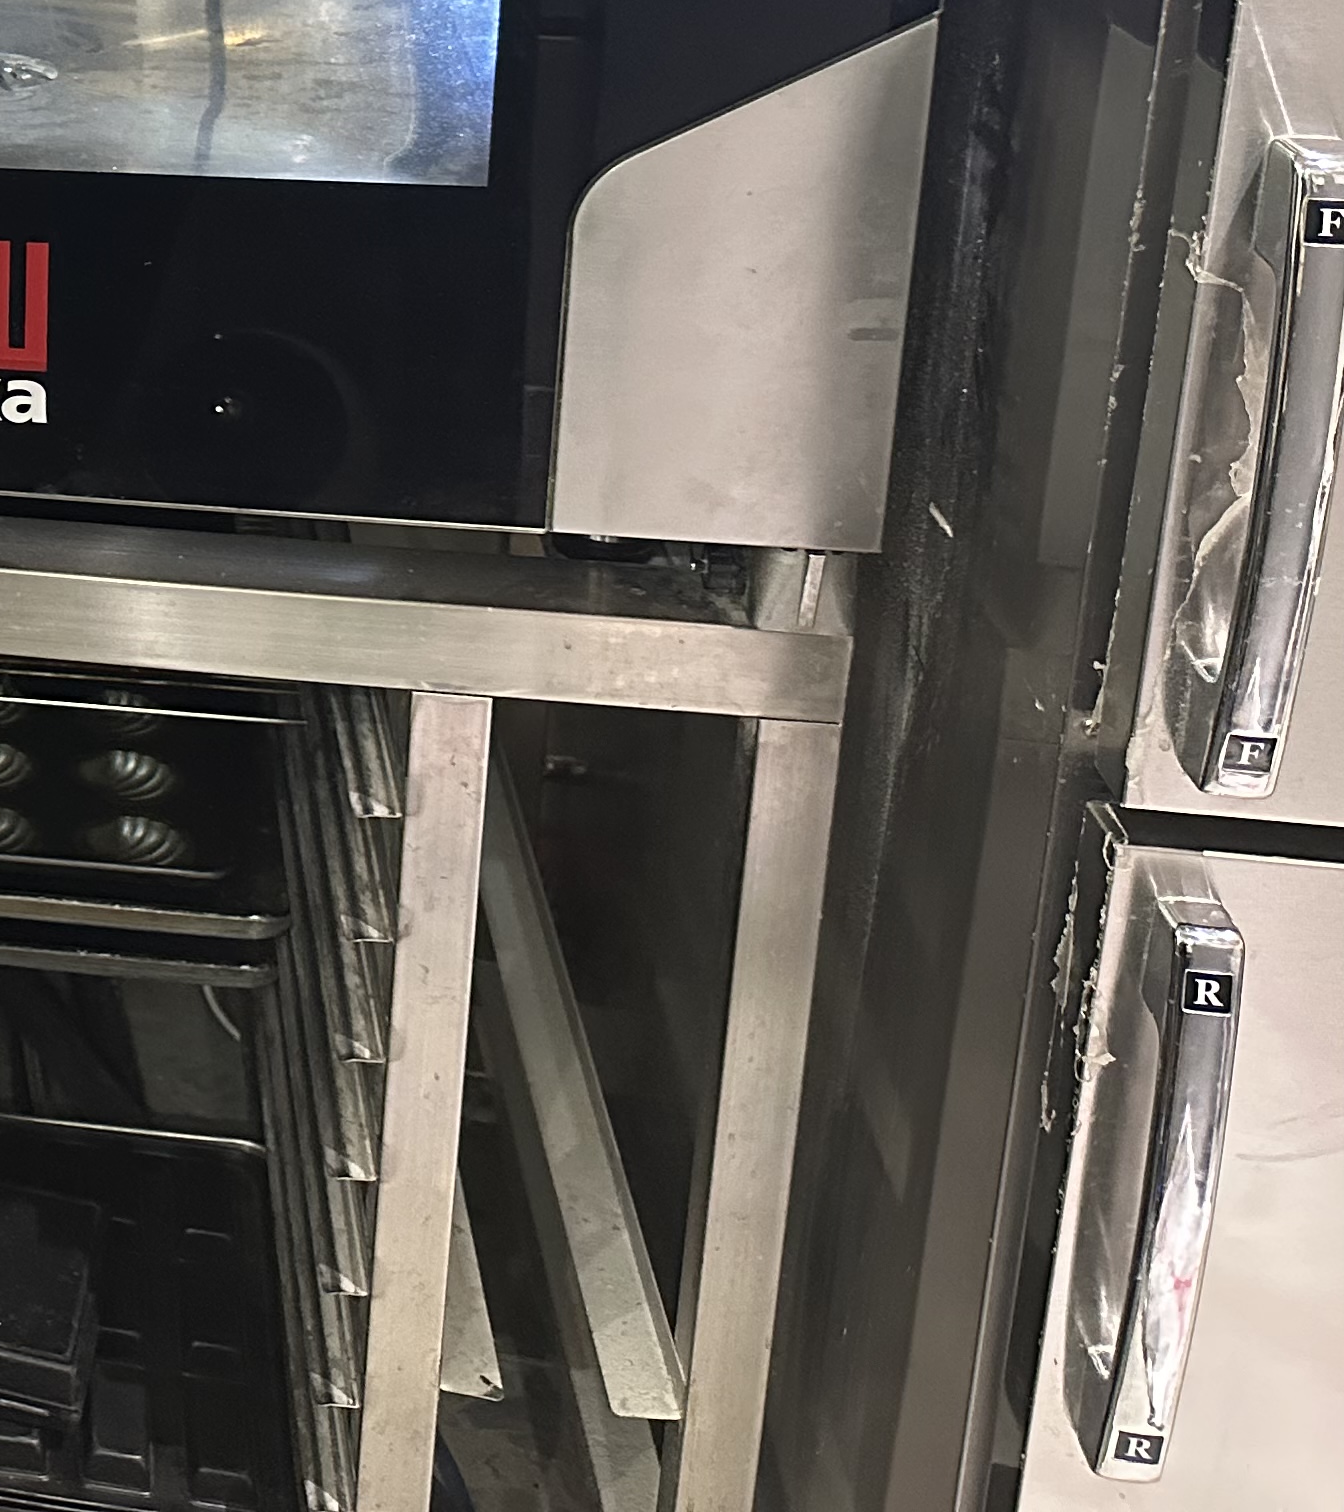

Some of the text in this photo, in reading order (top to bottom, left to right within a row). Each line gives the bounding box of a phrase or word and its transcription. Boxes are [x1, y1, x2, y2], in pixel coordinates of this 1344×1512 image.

[1317, 208, 1344, 237] F
[1236, 741, 1265, 765] F
[1193, 978, 1224, 1007] R
[1124, 1437, 1153, 1460] R
